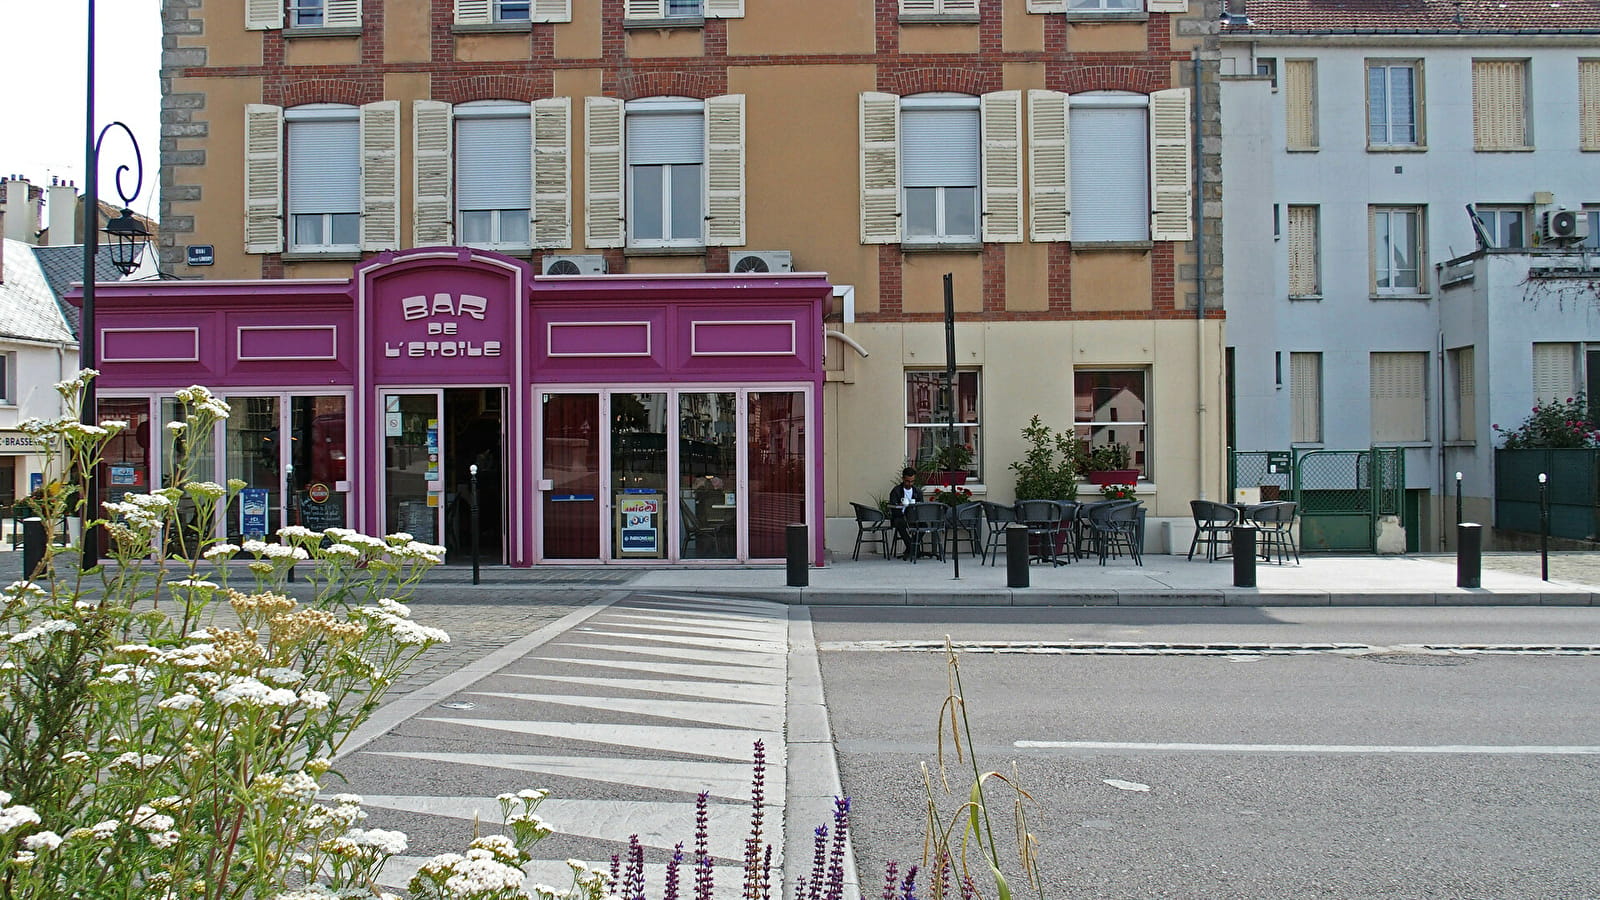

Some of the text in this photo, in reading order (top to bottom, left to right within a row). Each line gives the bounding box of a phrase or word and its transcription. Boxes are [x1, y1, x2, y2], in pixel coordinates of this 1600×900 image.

[401, 293, 488, 321] BAR
[428, 322, 458, 335] DE
[5, 437, 43, 446] BRASSE
